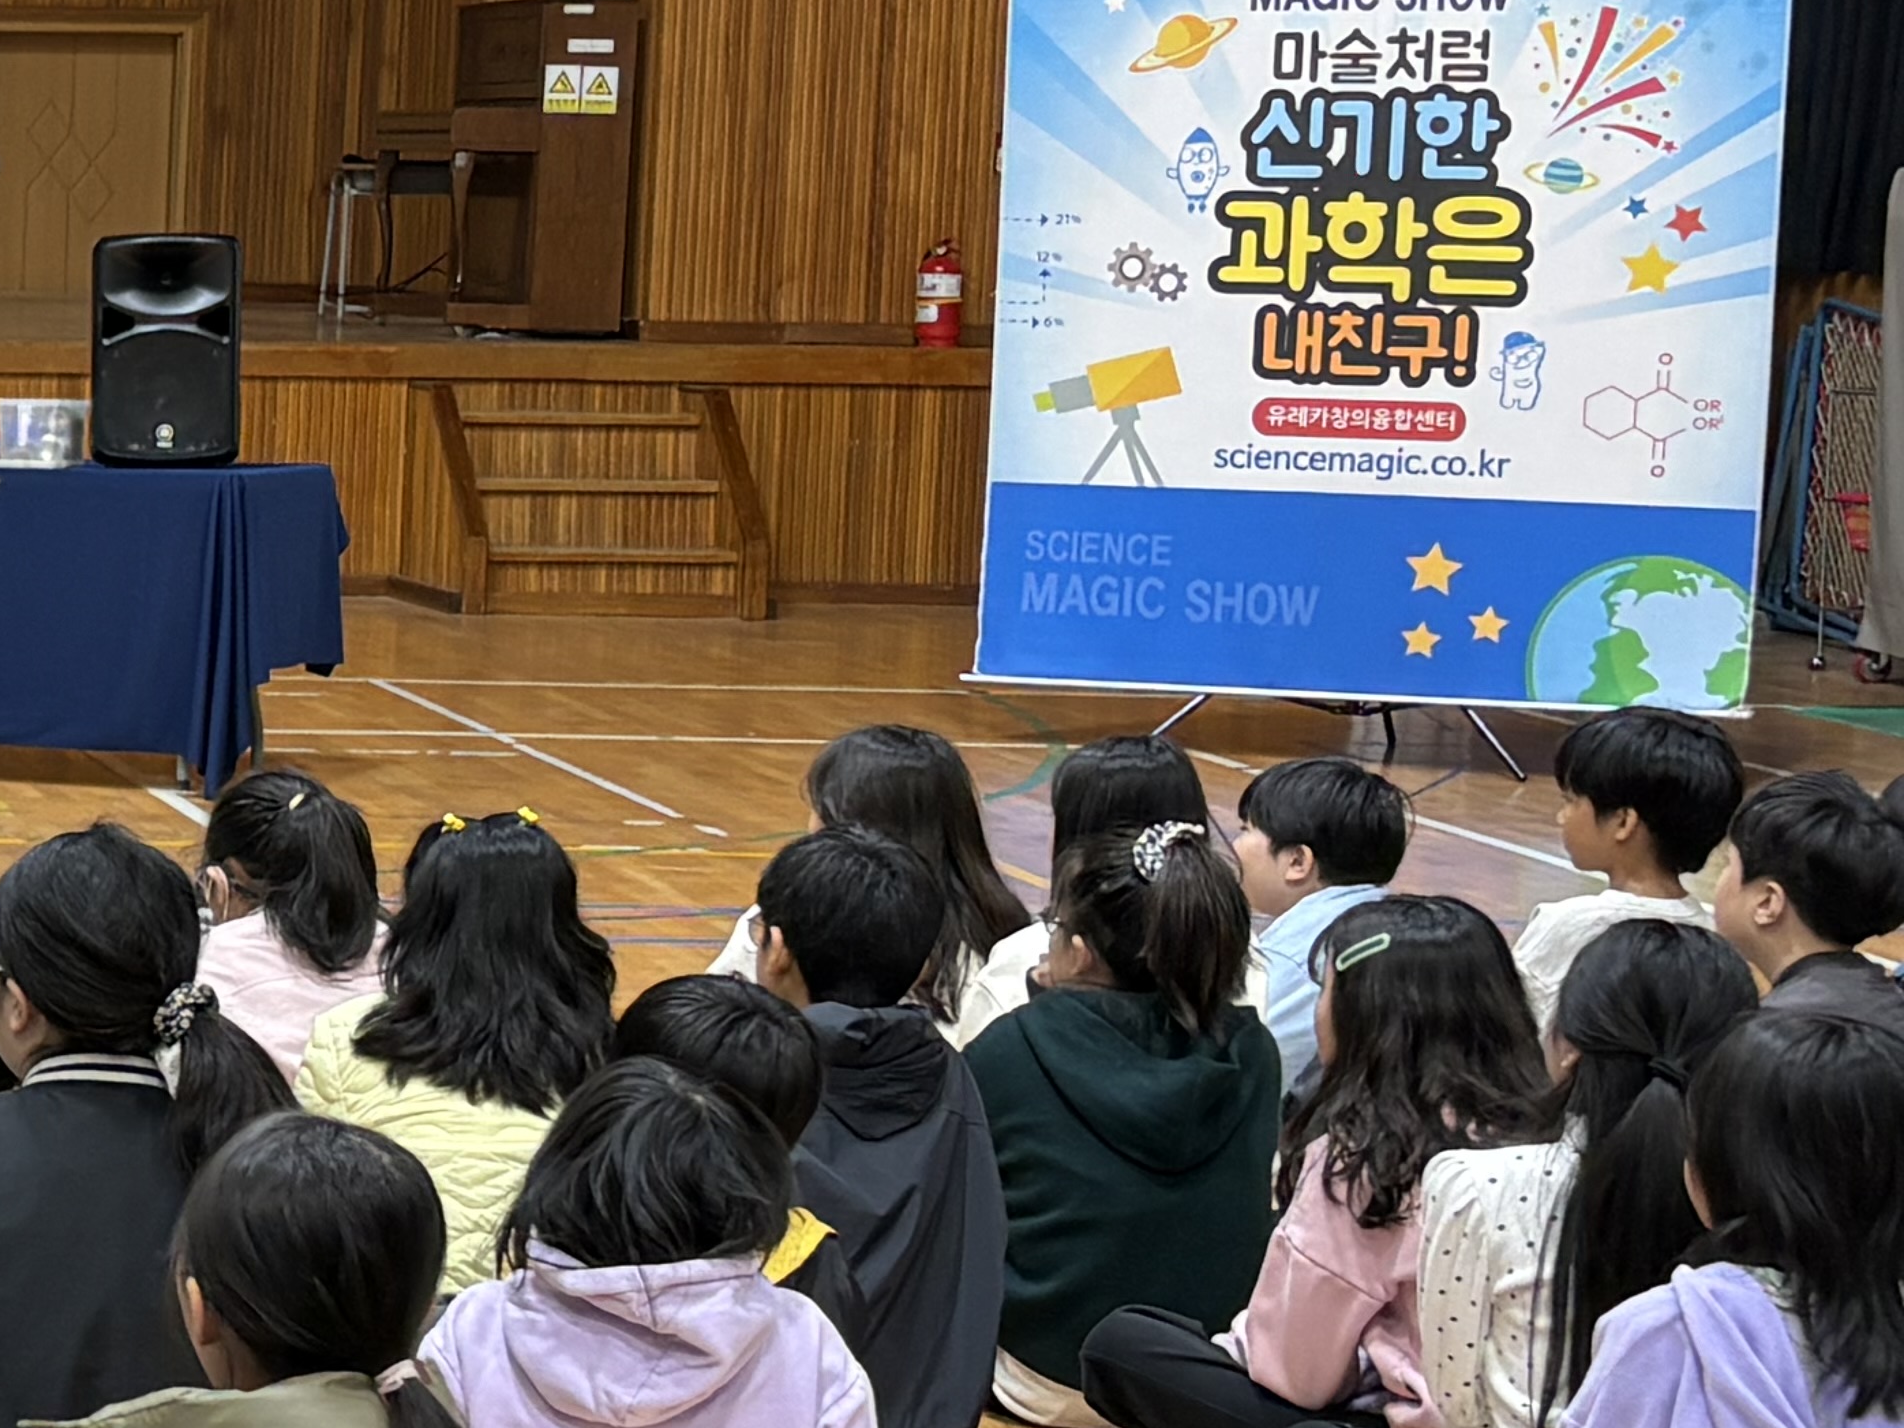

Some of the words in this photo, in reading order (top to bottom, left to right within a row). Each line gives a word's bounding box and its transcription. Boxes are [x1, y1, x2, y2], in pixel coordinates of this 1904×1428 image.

[1273, 28, 1491, 82] 마술처럼
[1249, 90, 1502, 183] 신기한
[1214, 193, 1527, 306] 과학은
[1264, 308, 1470, 380] 내친구!
[1264, 403, 1457, 433] 유레카창의융합센터
[1214, 441, 1510, 480] sciencemagic.co.kr
[1025, 529, 1173, 567] SCIENCE
[1021, 574, 1165, 619] MAGIC
[1184, 577, 1321, 628] SHOW
